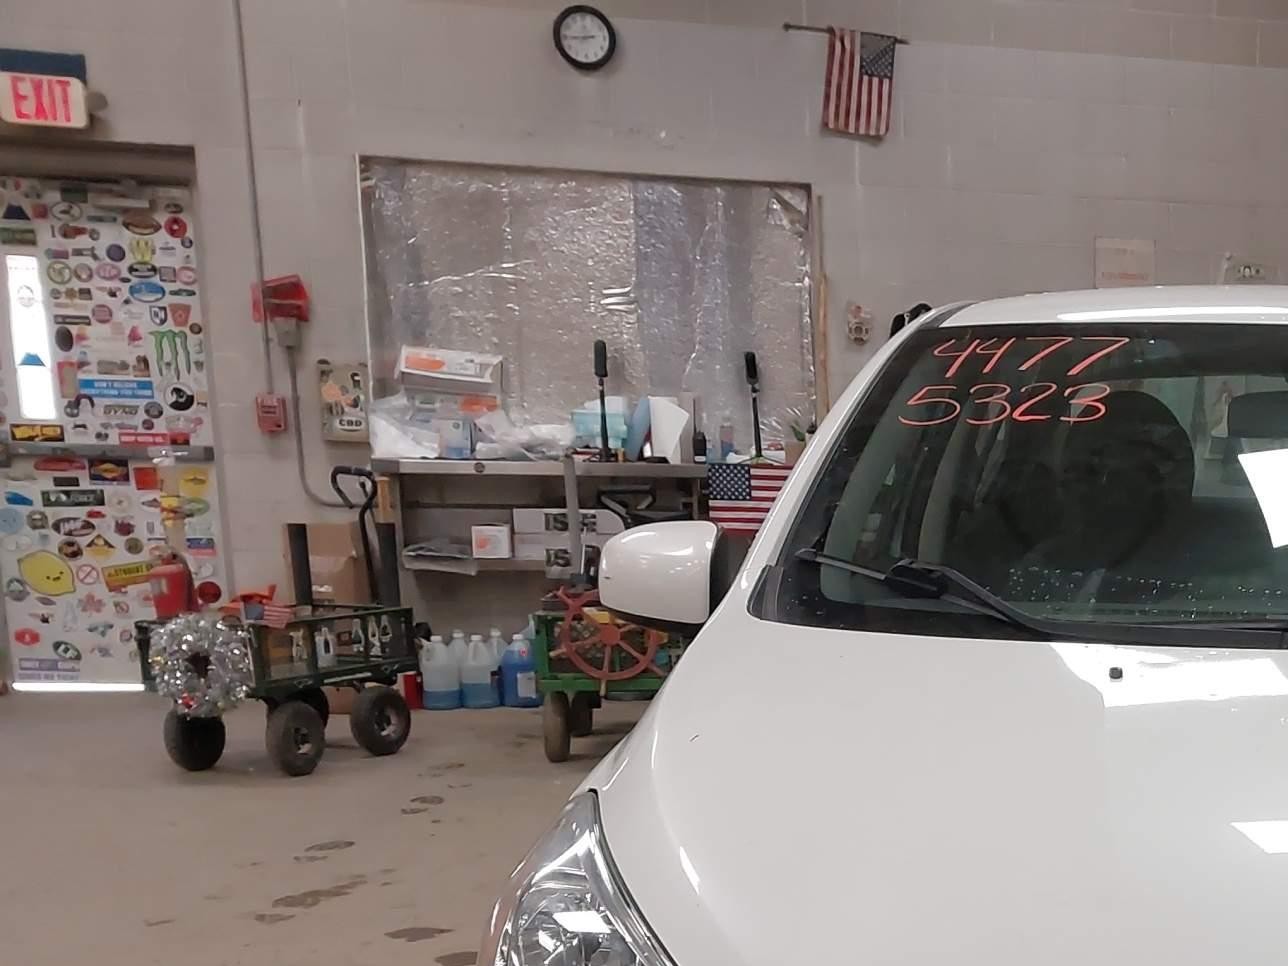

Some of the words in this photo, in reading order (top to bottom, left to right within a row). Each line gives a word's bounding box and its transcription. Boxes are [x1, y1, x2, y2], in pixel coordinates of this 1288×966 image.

[11, 75, 71, 122] EXIT
[933, 336, 1130, 379] 4477
[897, 383, 1111, 426] 5323
